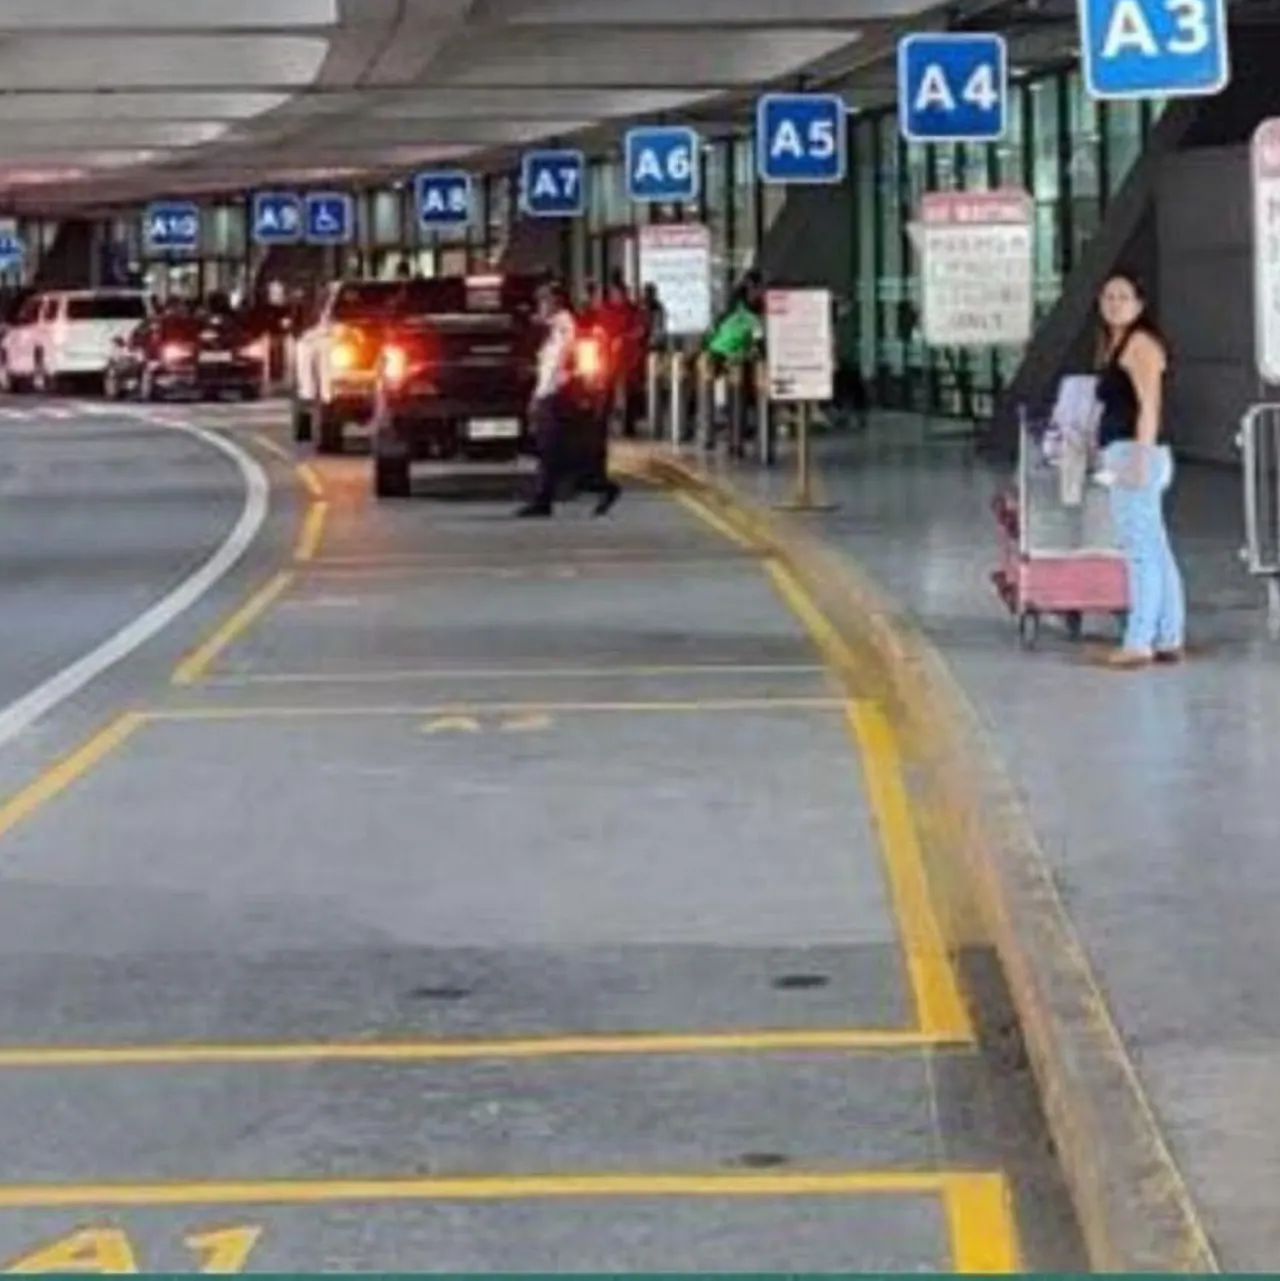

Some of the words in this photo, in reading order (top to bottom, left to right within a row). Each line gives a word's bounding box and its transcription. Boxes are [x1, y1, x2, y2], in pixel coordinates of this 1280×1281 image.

[913, 63, 999, 112] A4
[770, 118, 835, 158] A5
[633, 143, 691, 182] A6
[533, 168, 578, 198] A7
